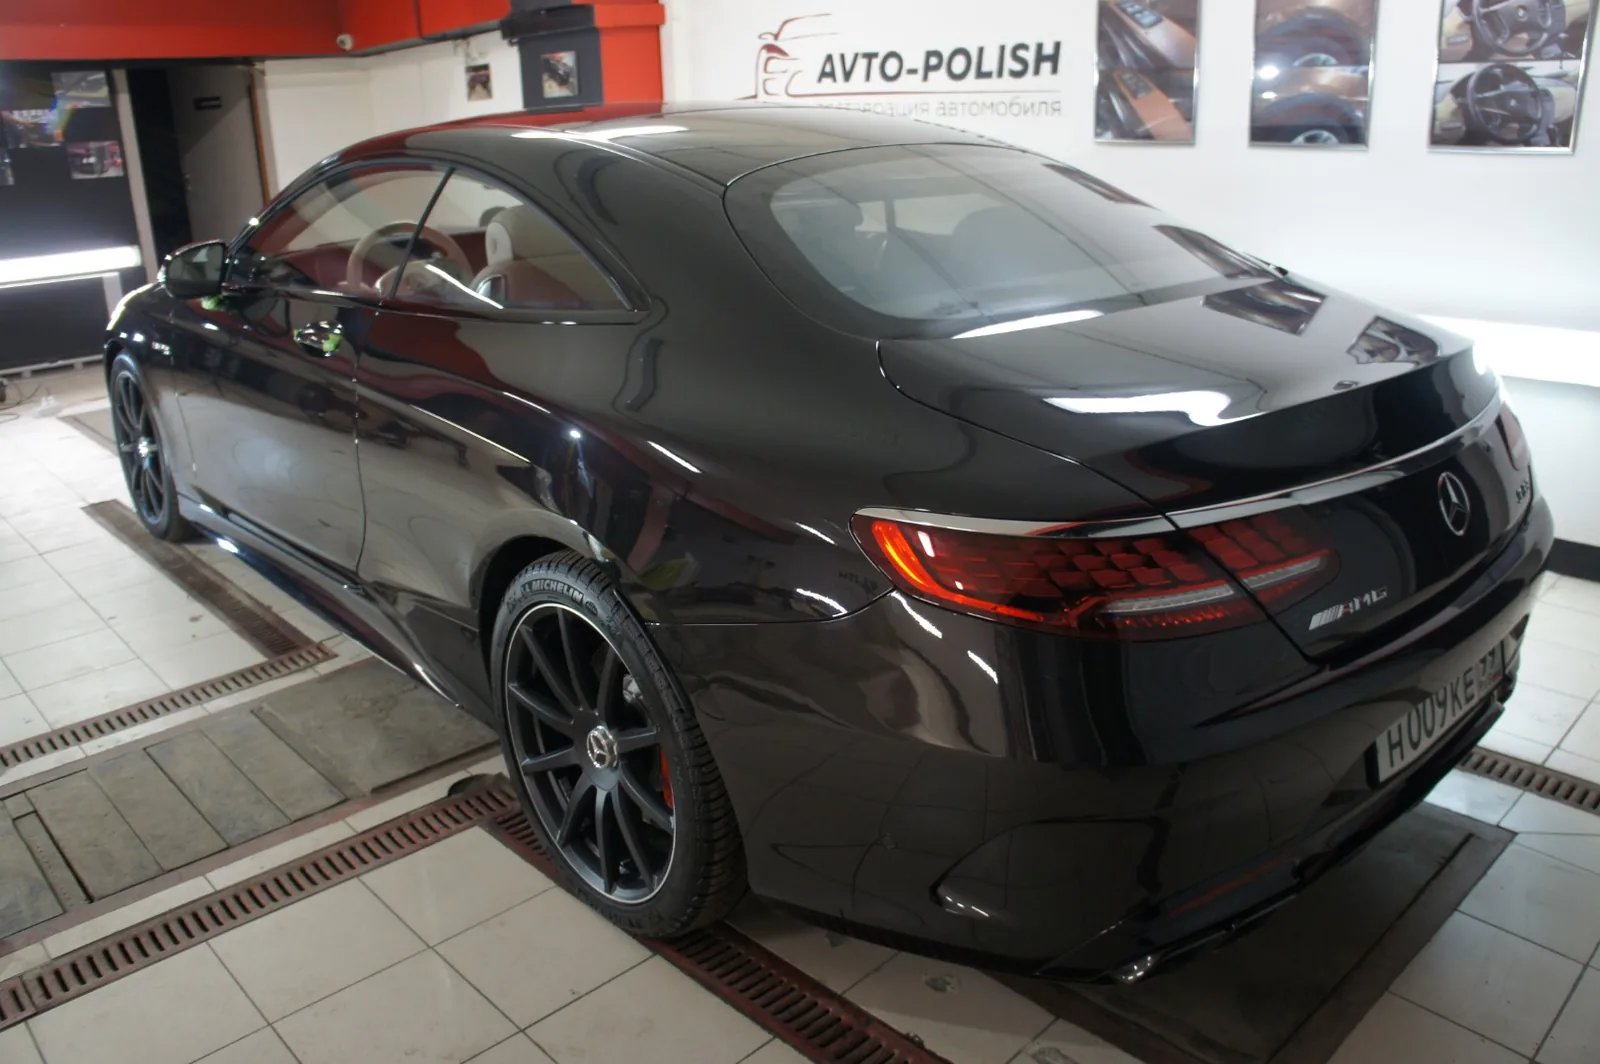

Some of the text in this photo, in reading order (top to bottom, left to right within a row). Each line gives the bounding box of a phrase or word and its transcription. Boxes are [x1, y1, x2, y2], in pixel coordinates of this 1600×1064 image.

[816, 41, 1062, 83] AVTO-POLISH
[935, 96, 1062, 118] автомобиля
[531, 579, 584, 601] MICHELIN
